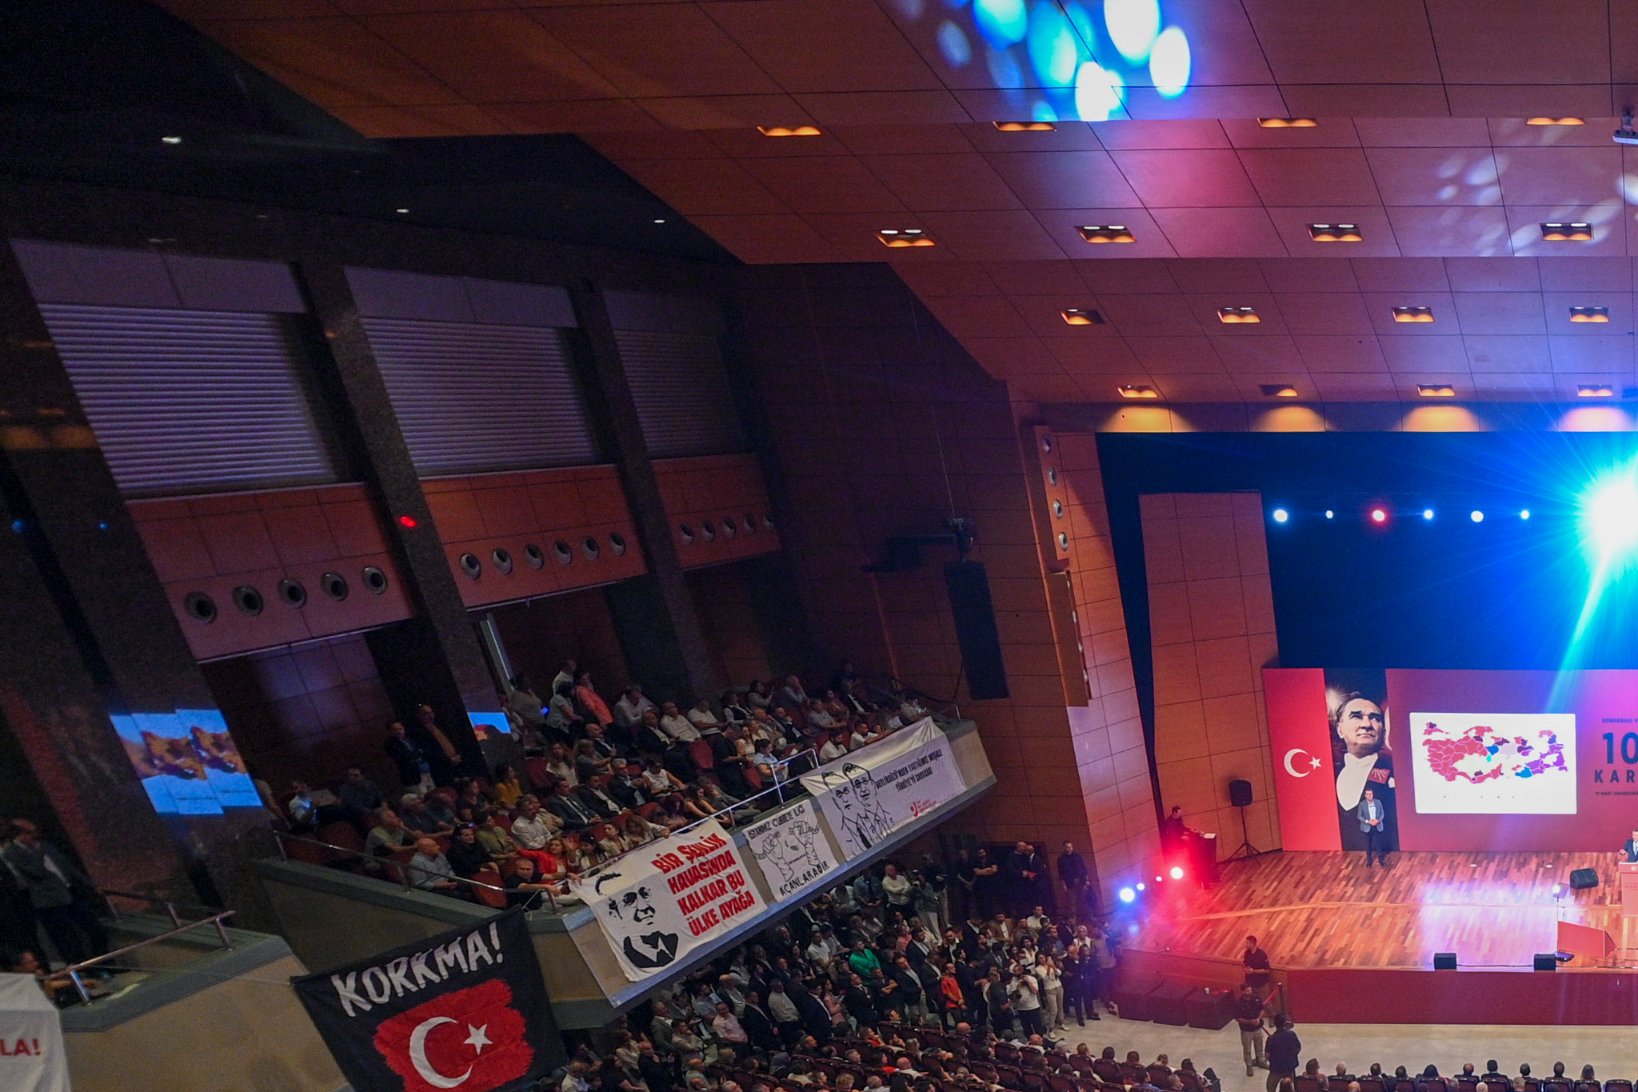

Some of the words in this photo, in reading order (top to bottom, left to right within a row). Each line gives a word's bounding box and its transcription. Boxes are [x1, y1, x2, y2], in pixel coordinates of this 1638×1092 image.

[651, 853, 685, 874] BİR
[667, 850, 737, 895] HAVASINDA
[677, 879, 729, 917] KALKAR
[726, 869, 746, 891] BU
[686, 908, 721, 936] ÜLKE
[719, 889, 756, 920] AYAĞA
[331, 921, 503, 1017] KORKMA!
